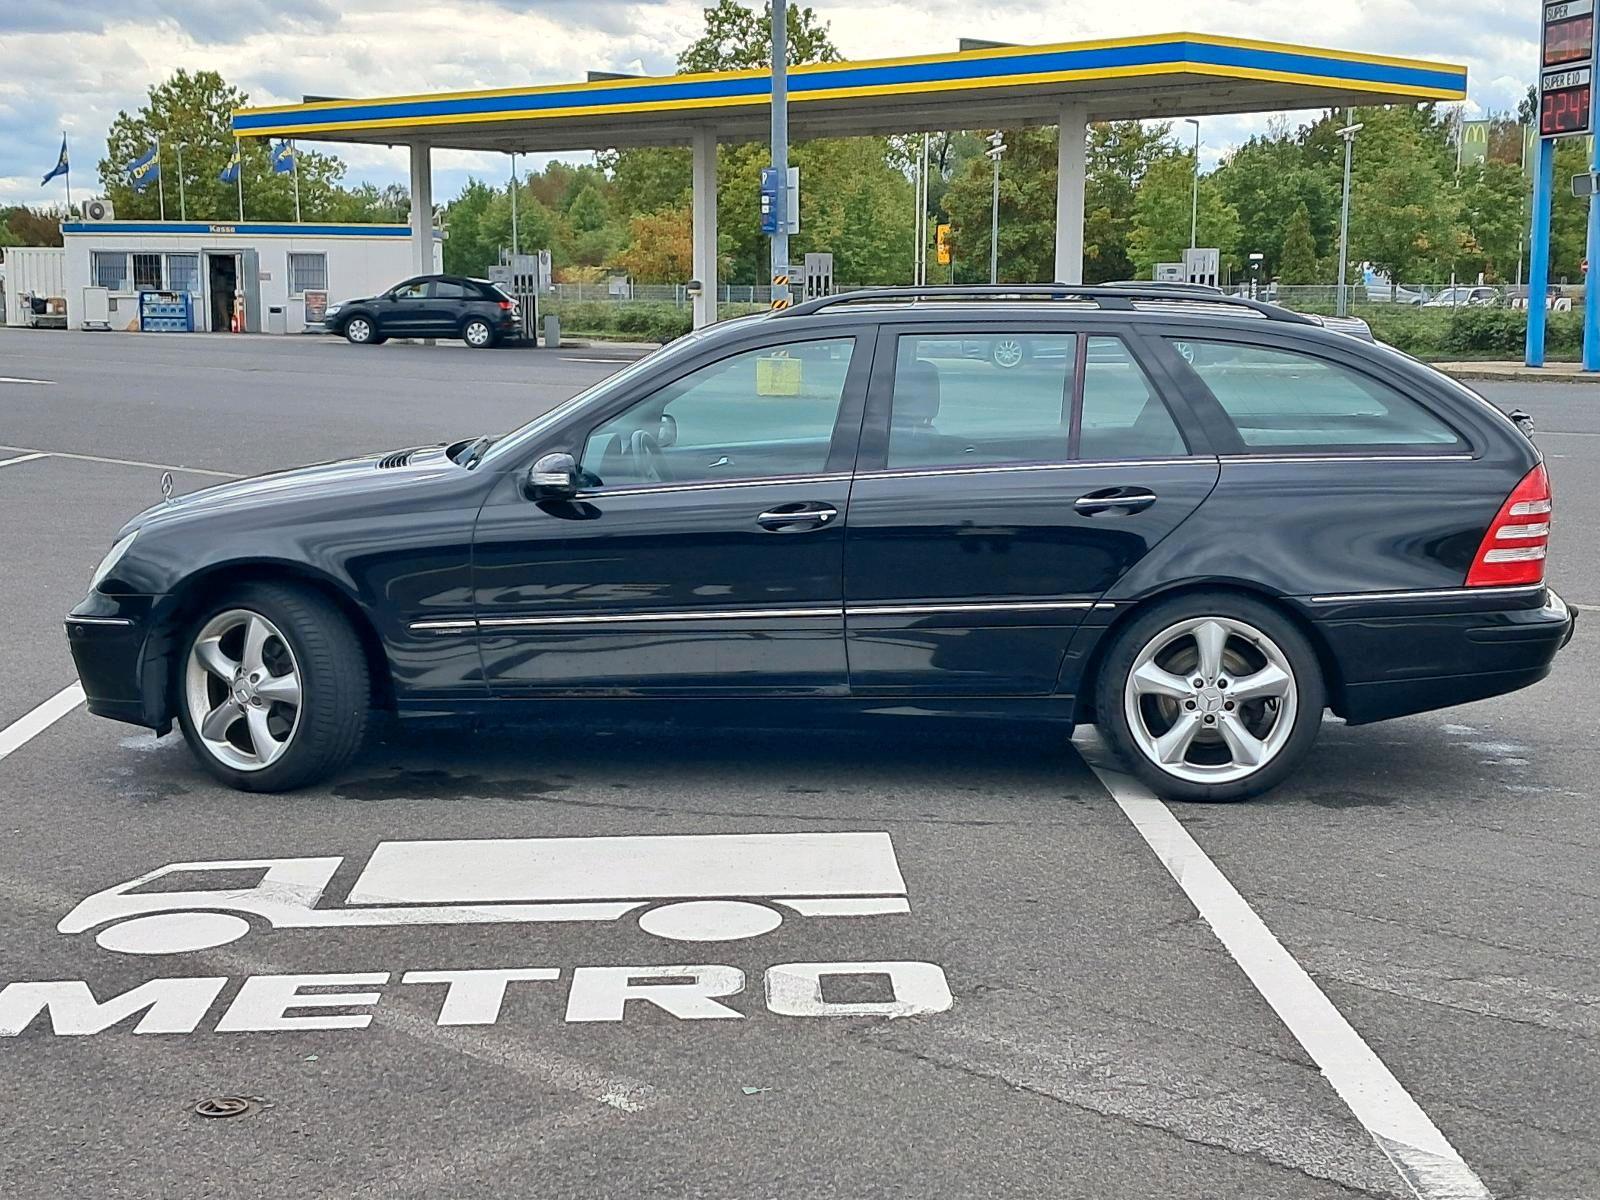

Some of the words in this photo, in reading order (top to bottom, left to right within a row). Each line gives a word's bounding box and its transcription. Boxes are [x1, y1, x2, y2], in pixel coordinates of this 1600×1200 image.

[1547, 4, 1569, 21] SUPER
[1544, 74, 1565, 89] SUPER
[1566, 71, 1580, 86] E10
[209, 224, 236, 233] Kasse
[0, 961, 954, 1036] METRO
